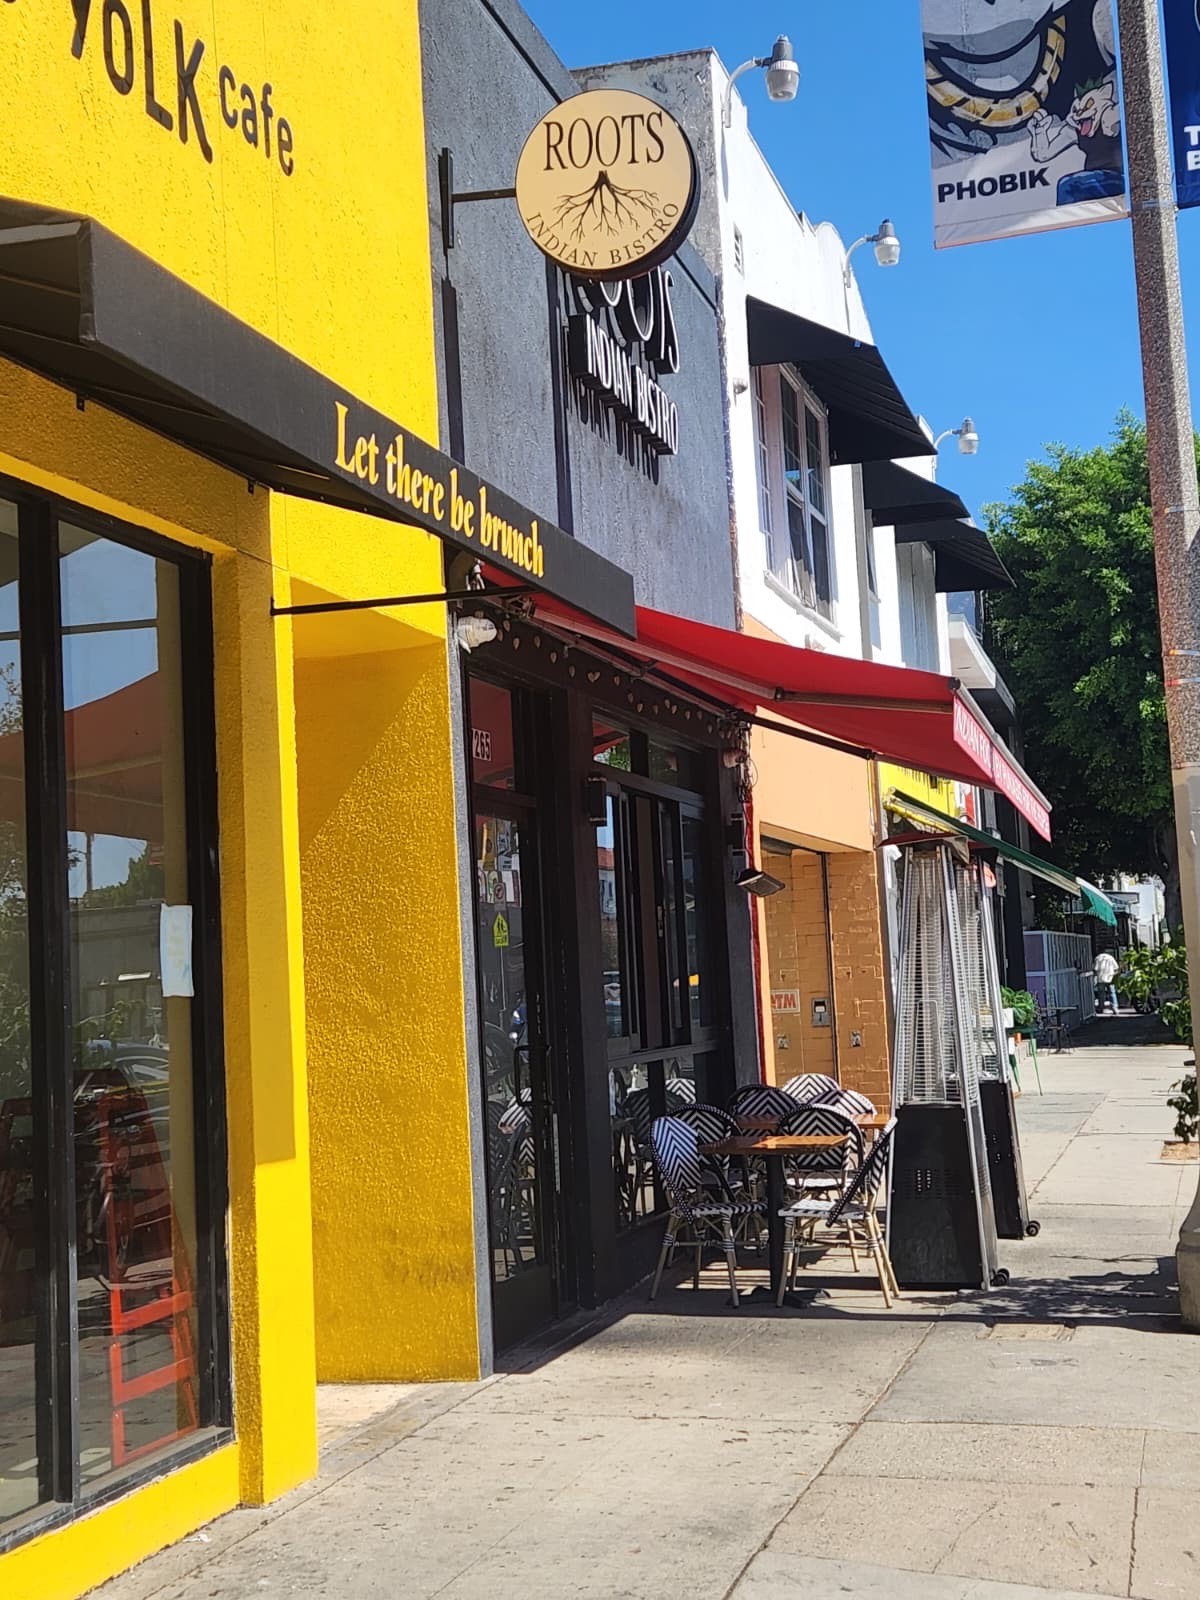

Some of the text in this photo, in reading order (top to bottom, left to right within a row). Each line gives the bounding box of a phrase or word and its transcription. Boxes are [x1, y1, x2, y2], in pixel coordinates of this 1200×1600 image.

[218, 64, 294, 177] cafe
[543, 111, 665, 171] ROOTS
[526, 203, 679, 267] INDIAN BISTRO
[938, 167, 1050, 203] PHOBIK
[600, 264, 680, 374] OTS
[586, 313, 679, 455] INDIAN BISTRO
[334, 401, 544, 578] Let there be brunch
